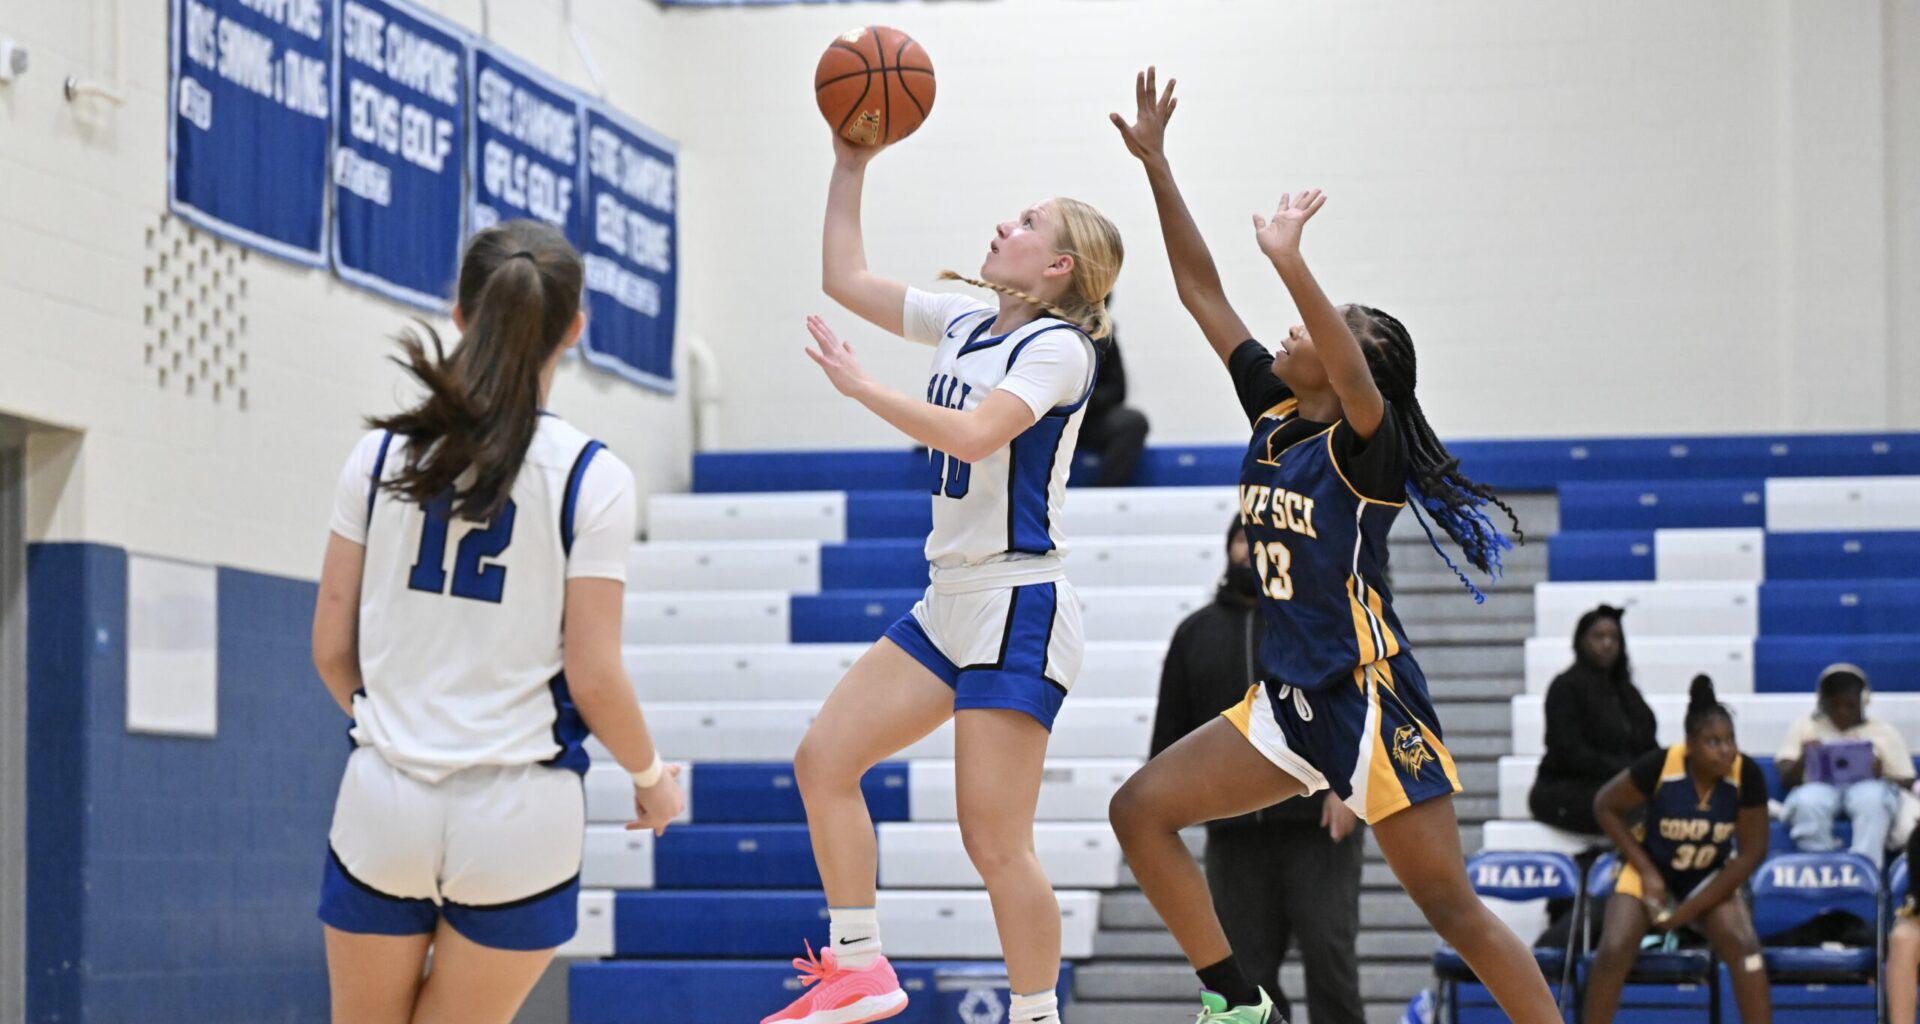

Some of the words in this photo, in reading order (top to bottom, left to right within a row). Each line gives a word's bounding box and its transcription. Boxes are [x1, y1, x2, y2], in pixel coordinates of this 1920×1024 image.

[1271, 487, 1318, 539] SCI
[408, 486, 517, 604] 12
[1254, 540, 1294, 601] 13
[1659, 818, 1710, 840] COMP
[1671, 844, 1717, 871] 30
[1477, 864, 1561, 888] HALL
[1772, 864, 1861, 888] HALL
